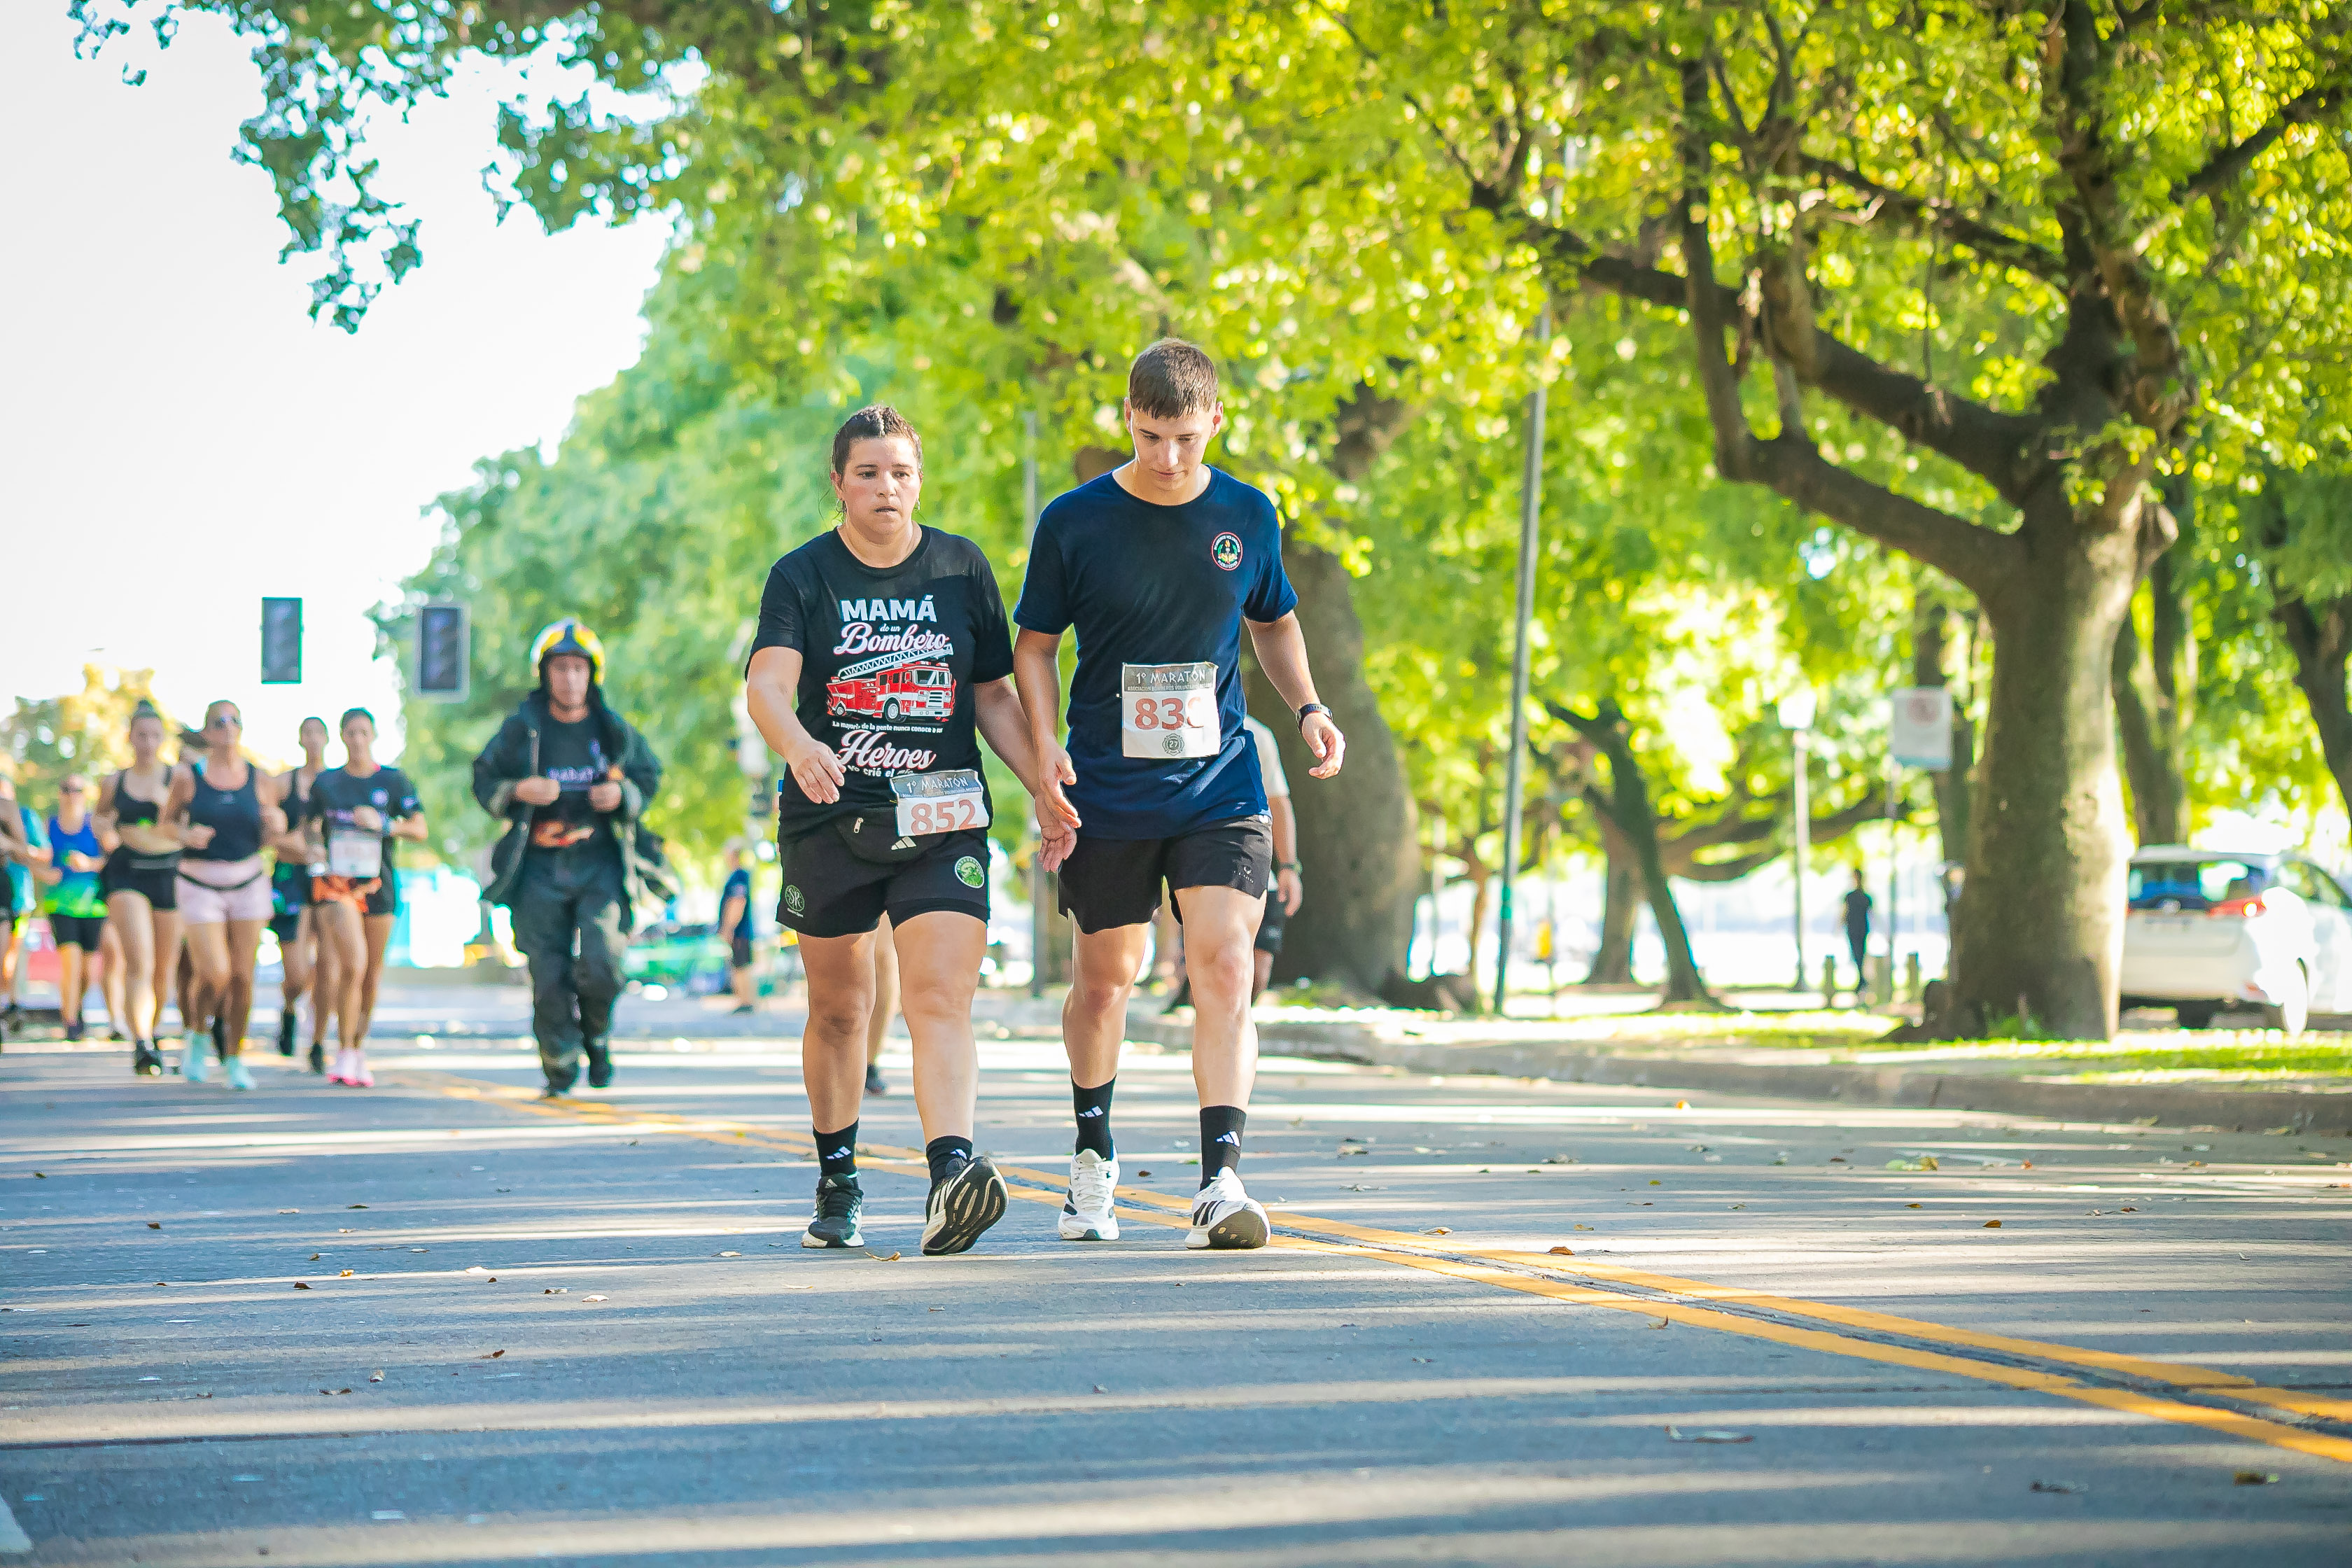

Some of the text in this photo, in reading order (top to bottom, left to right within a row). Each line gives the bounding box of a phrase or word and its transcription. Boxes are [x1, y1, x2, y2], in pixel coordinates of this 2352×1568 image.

[841, 595, 937, 622] MAMÁ
[834, 622, 949, 655] Bombero
[1150, 666, 1205, 684] MARATÓN
[885, 769, 895, 777] el
[921, 774, 969, 791] MARATÓN
[911, 799, 977, 836] 852
